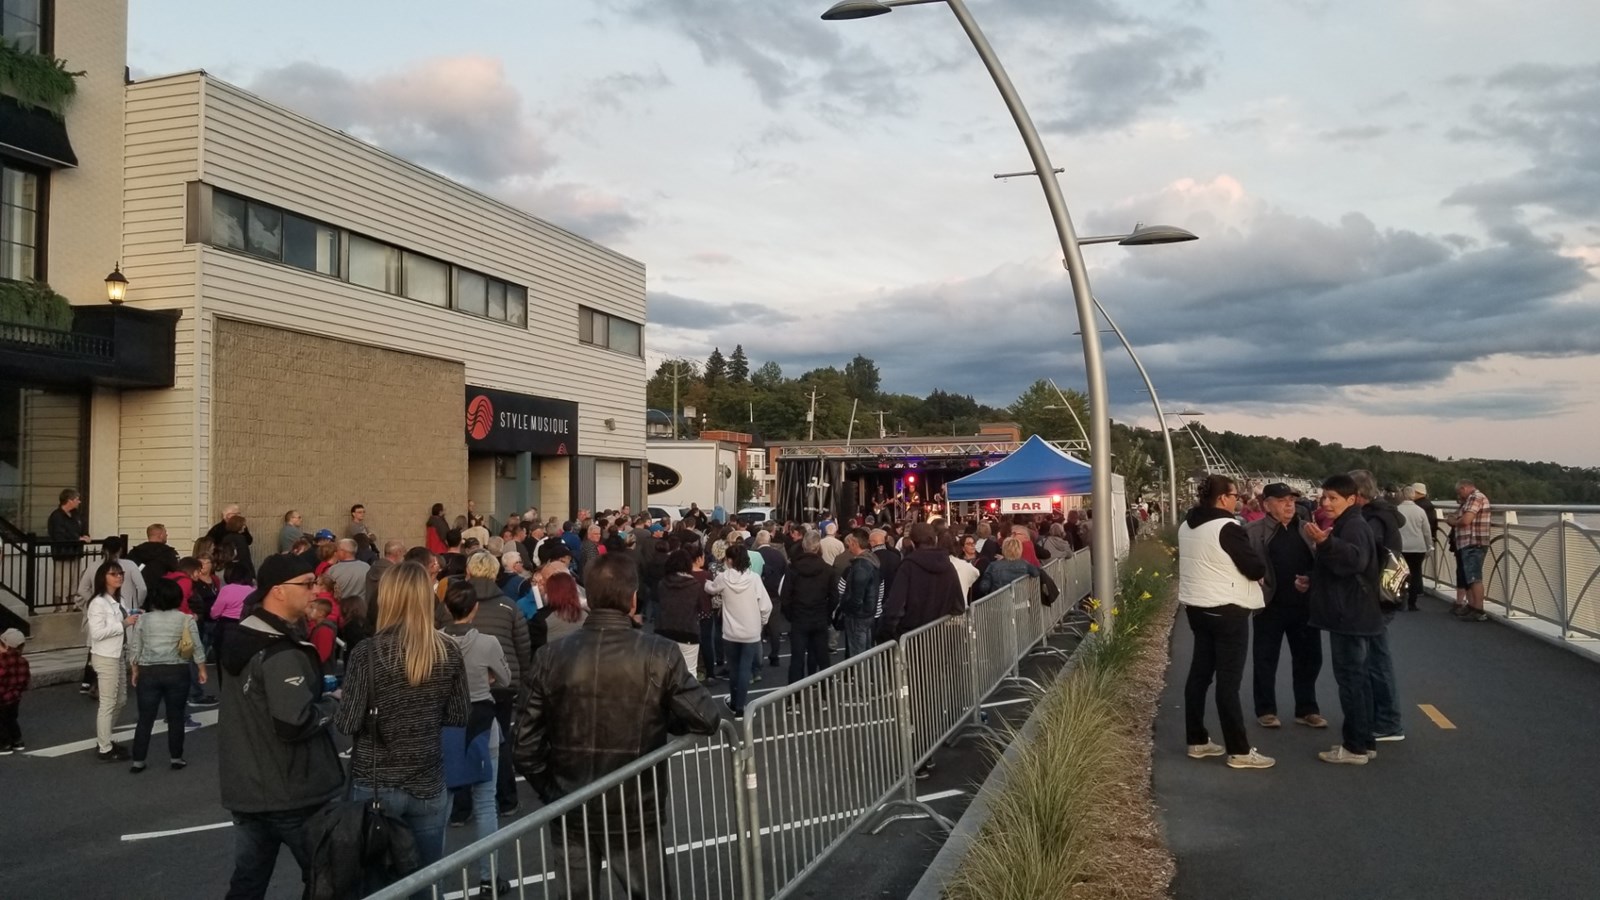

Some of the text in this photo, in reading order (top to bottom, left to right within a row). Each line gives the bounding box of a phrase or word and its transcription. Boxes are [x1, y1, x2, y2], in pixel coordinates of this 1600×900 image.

[500, 411, 569, 435] STYLE MUSIQUE
[1011, 502, 1042, 511] BAR
